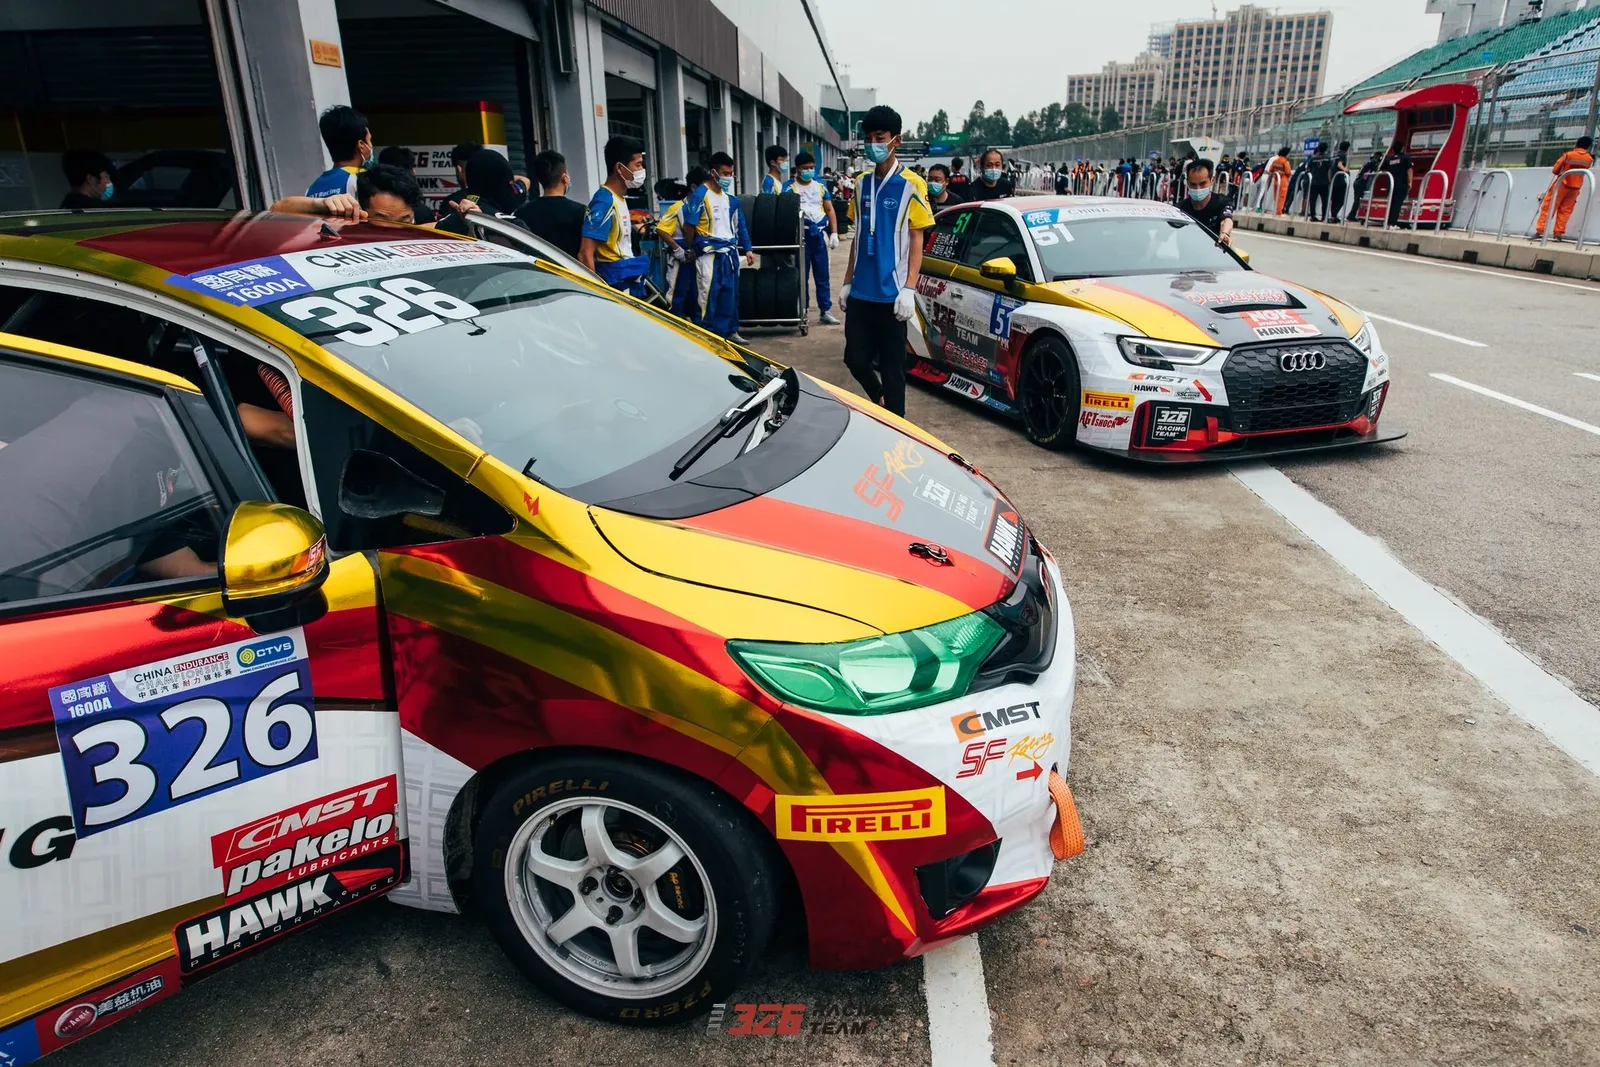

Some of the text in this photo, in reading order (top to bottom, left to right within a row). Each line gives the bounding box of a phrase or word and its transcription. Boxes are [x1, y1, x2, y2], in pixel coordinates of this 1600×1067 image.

[953, 212, 972, 233] 51
[1028, 223, 1075, 246] 51
[305, 247, 398, 268] CHINA
[226, 277, 306, 302] 1600A
[280, 277, 480, 347] 326
[994, 307, 1012, 338] 51
[1246, 309, 1294, 322] NGK
[957, 327, 979, 346] TEAM
[1256, 326, 1299, 336] HAWK
[948, 375, 972, 393] HAWK
[1133, 384, 1159, 392] HAWK
[1085, 393, 1130, 408] PIRELLI
[1157, 410, 1188, 423] 326
[990, 514, 1018, 567] HAWK
[256, 642, 292, 657] CTVS
[134, 651, 229, 684] CHINA ENDURANCE
[136, 661, 231, 693] CHAMPIONSHIP
[138, 669, 233, 699] 中国汽车耐力锦标赛
[68, 697, 112, 719] 1600A
[958, 701, 1041, 734] CMST
[72, 671, 314, 827] 326
[956, 738, 1007, 779] SF
[512, 779, 610, 816] PIRELLI
[237, 782, 389, 850] CMST
[790, 798, 934, 834] PIRELLI
[225, 813, 395, 897] pakelo
[287, 836, 390, 881] LUBRICANTS
[185, 873, 332, 960] HAWK
[190, 876, 394, 968] PERFORMANCE
[98, 978, 162, 1016] 美益机油
